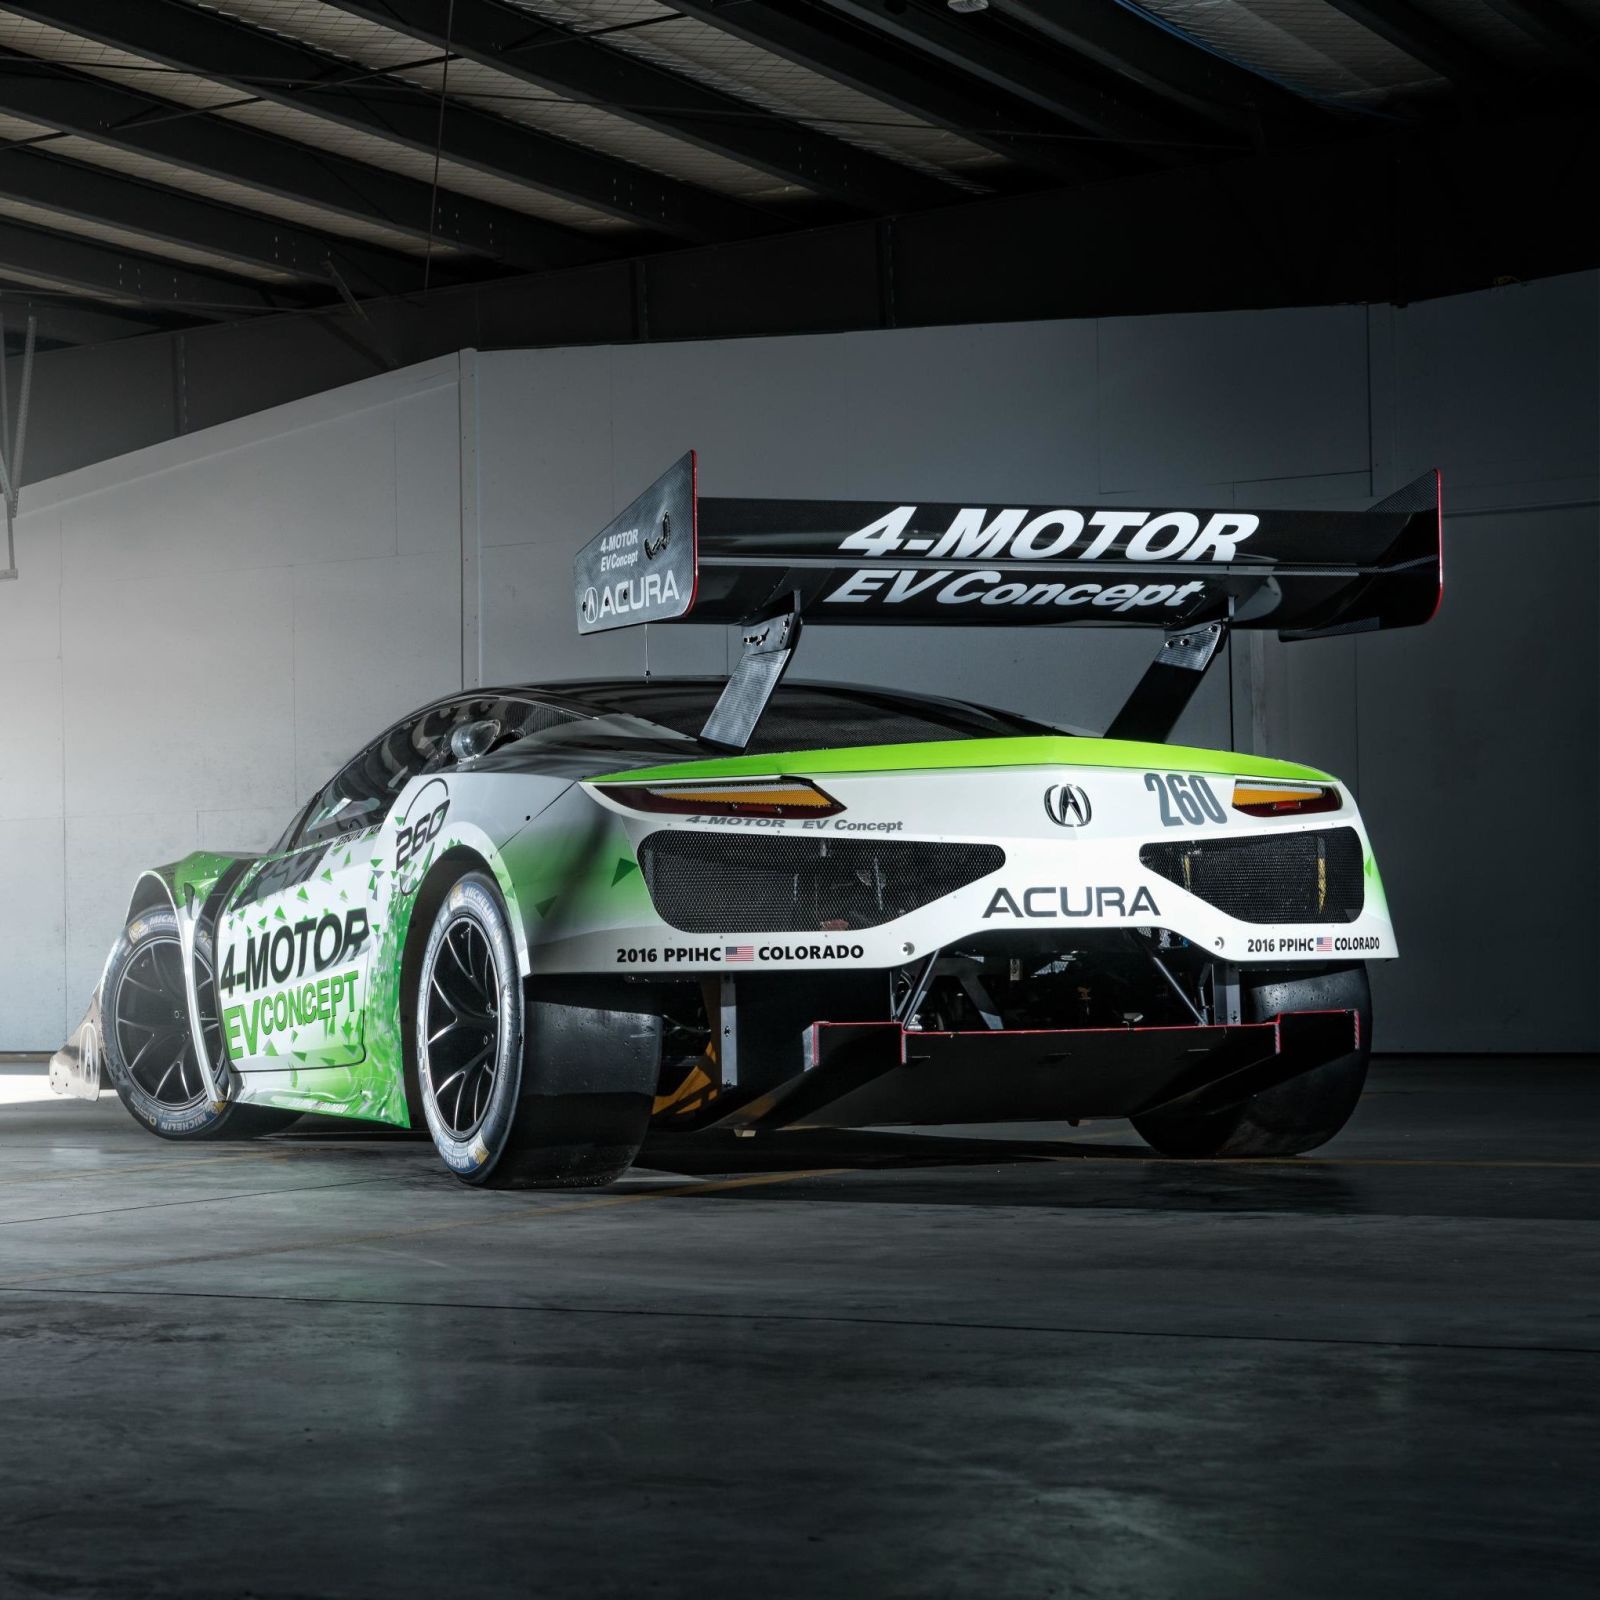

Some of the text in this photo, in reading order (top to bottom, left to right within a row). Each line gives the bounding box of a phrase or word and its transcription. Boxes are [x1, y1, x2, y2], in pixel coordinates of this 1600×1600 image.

[600, 529, 638, 552] 4-MOTOR
[838, 506, 1259, 561] 4-MOTOR
[600, 570, 680, 618] ACURA
[822, 569, 1205, 611] EV Concept
[1144, 772, 1227, 827] 260
[396, 799, 450, 871] 260
[685, 815, 903, 833] 4-MOTOR EV Concept
[982, 886, 1162, 919] ACURA
[220, 907, 370, 998] 4-MOTOR
[616, 944, 865, 963] 2016 PPIHC COLORADO
[1247, 936, 1380, 953] 2016 PPIHC COLORADO
[160, 1112, 207, 1132] MICHELIN
